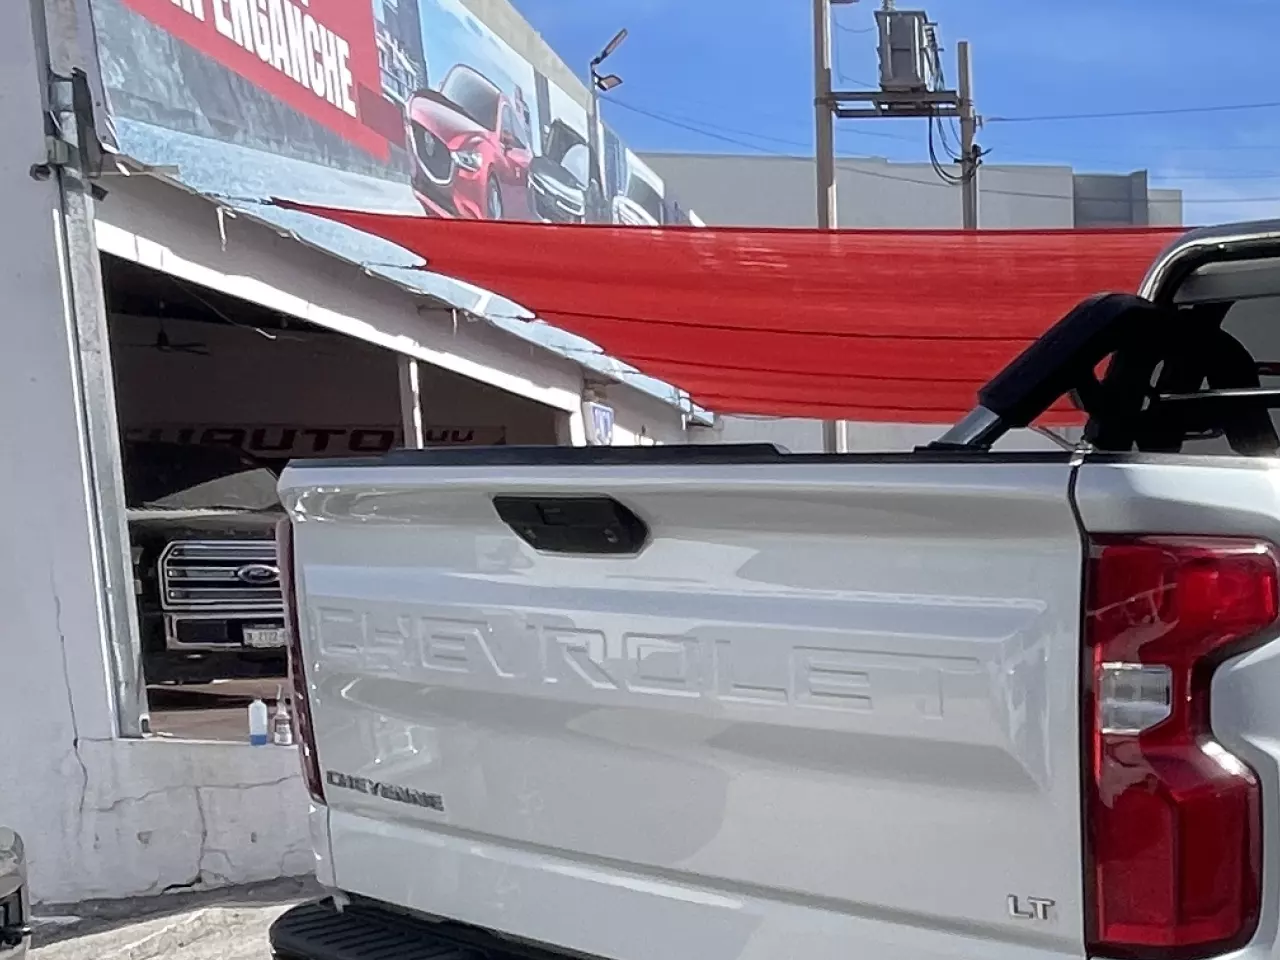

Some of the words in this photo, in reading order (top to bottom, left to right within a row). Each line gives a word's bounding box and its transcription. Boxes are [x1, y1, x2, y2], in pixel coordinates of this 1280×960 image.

[316, 606, 981, 720] CHEVROLET
[326, 770, 444, 812] CHEYENNE
[1007, 893, 1056, 920] LT
